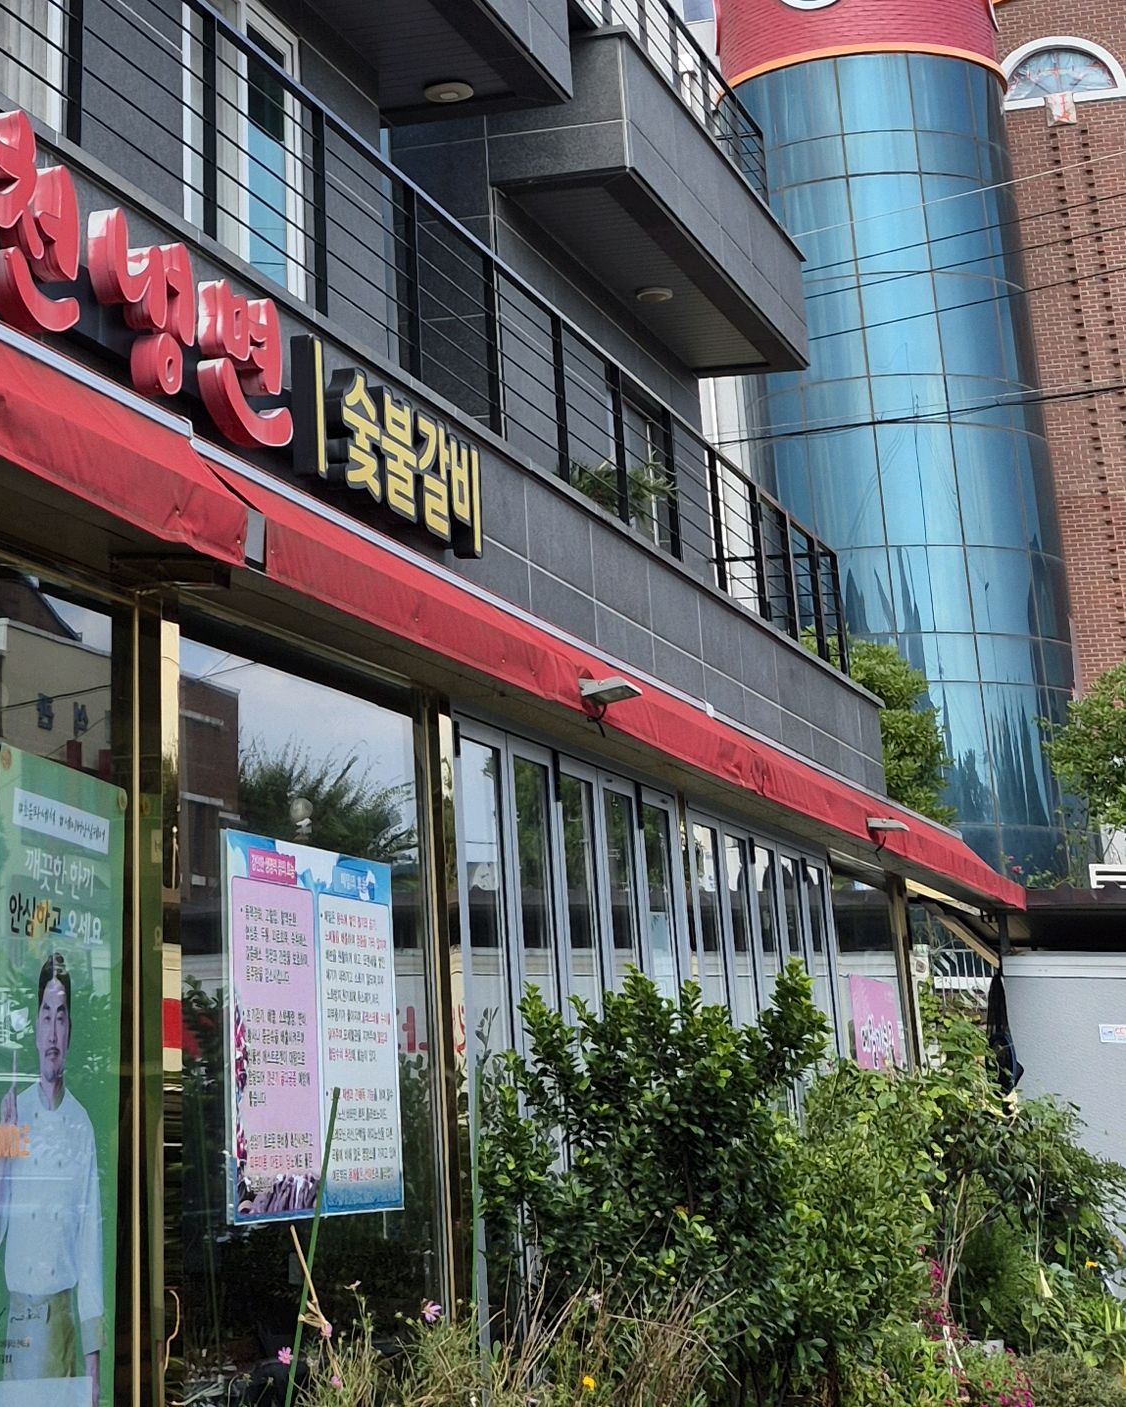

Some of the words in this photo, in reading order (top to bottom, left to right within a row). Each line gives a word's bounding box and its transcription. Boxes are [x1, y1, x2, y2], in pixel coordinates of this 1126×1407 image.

[341, 376, 482, 554] 숯불갈비
[25, 848, 66, 895] 깨끗한
[70, 860, 95, 899] 한끼
[9, 893, 62, 937] 안심하고
[65, 909, 103, 944] 오세요
